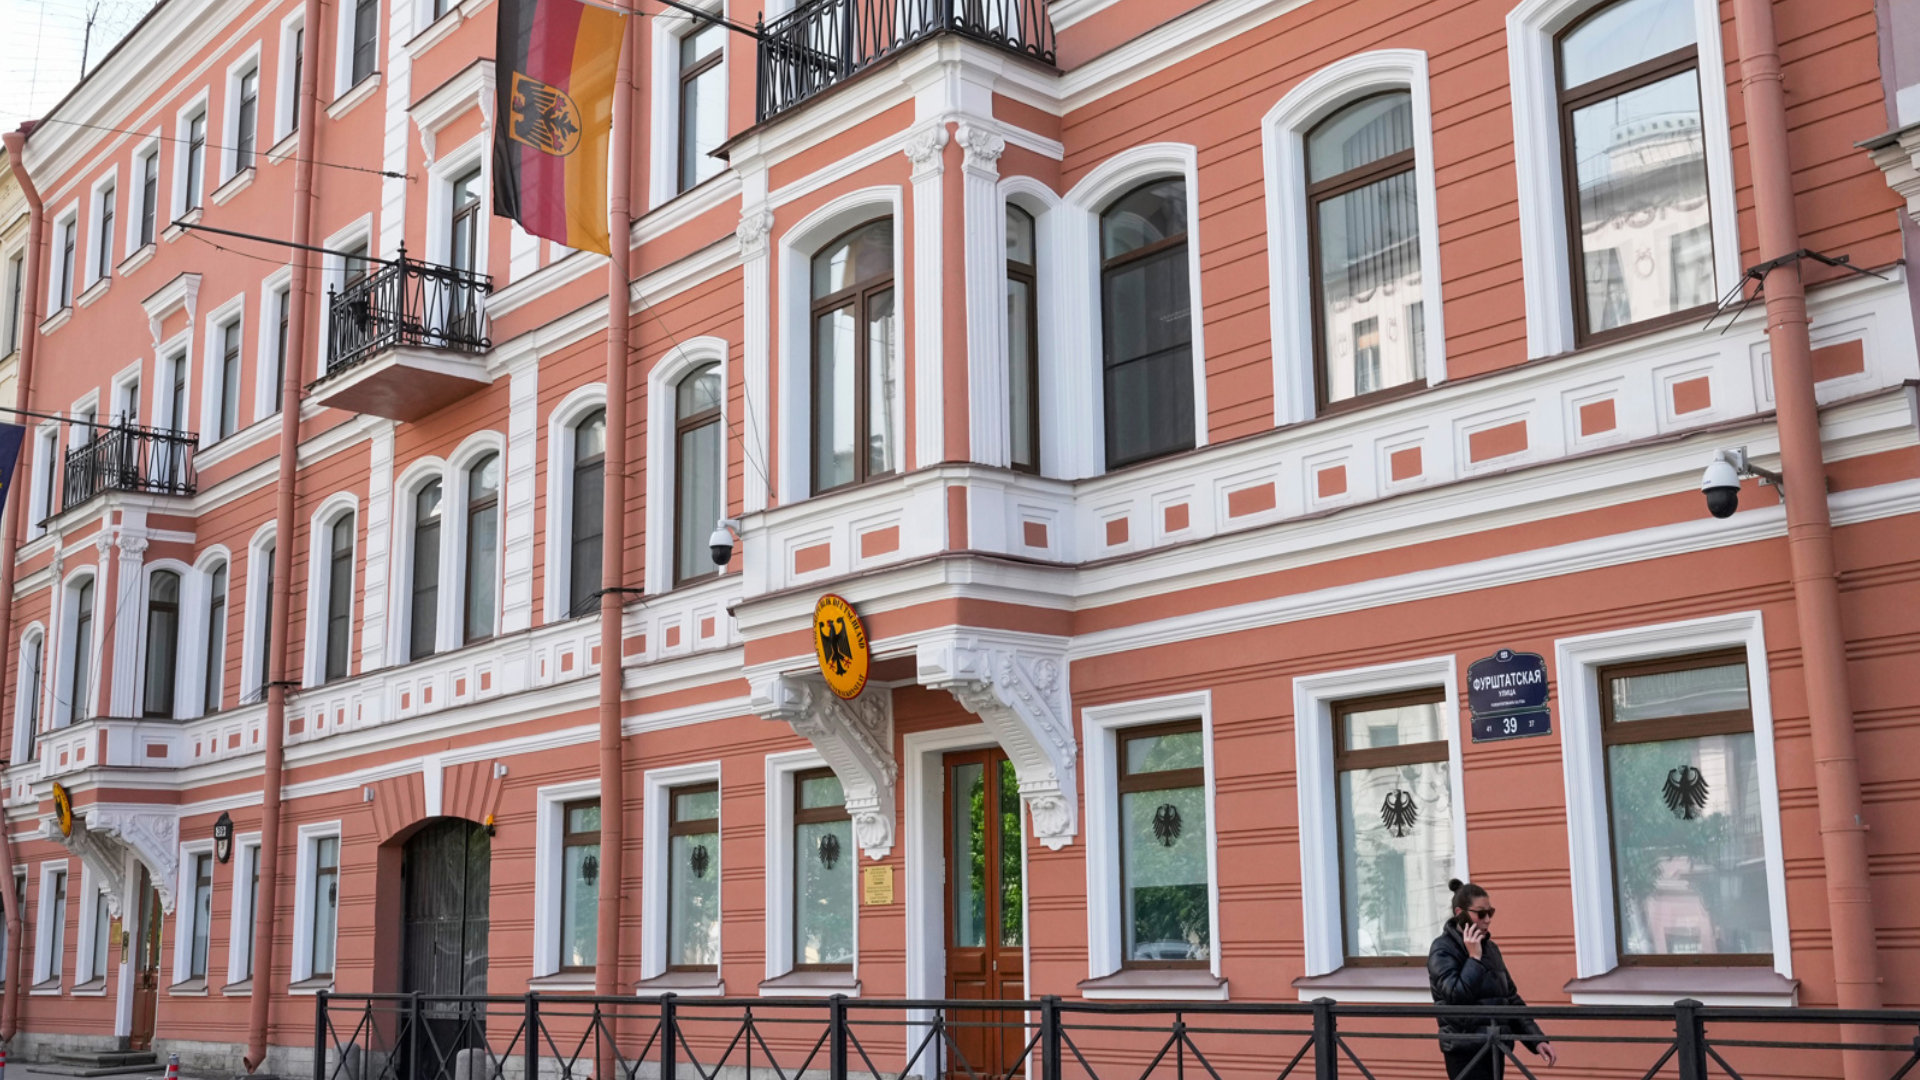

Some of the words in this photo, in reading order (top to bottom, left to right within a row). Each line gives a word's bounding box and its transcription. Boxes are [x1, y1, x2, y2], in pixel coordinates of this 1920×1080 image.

[833, 598, 865, 650] DEUTSCHLAND
[1473, 670, 1541, 691] ФУРШТАТСКАЯ
[1498, 689, 1516, 697] УЛИЦА
[1503, 717, 1517, 734] 39
[1529, 720, 1535, 728] 37
